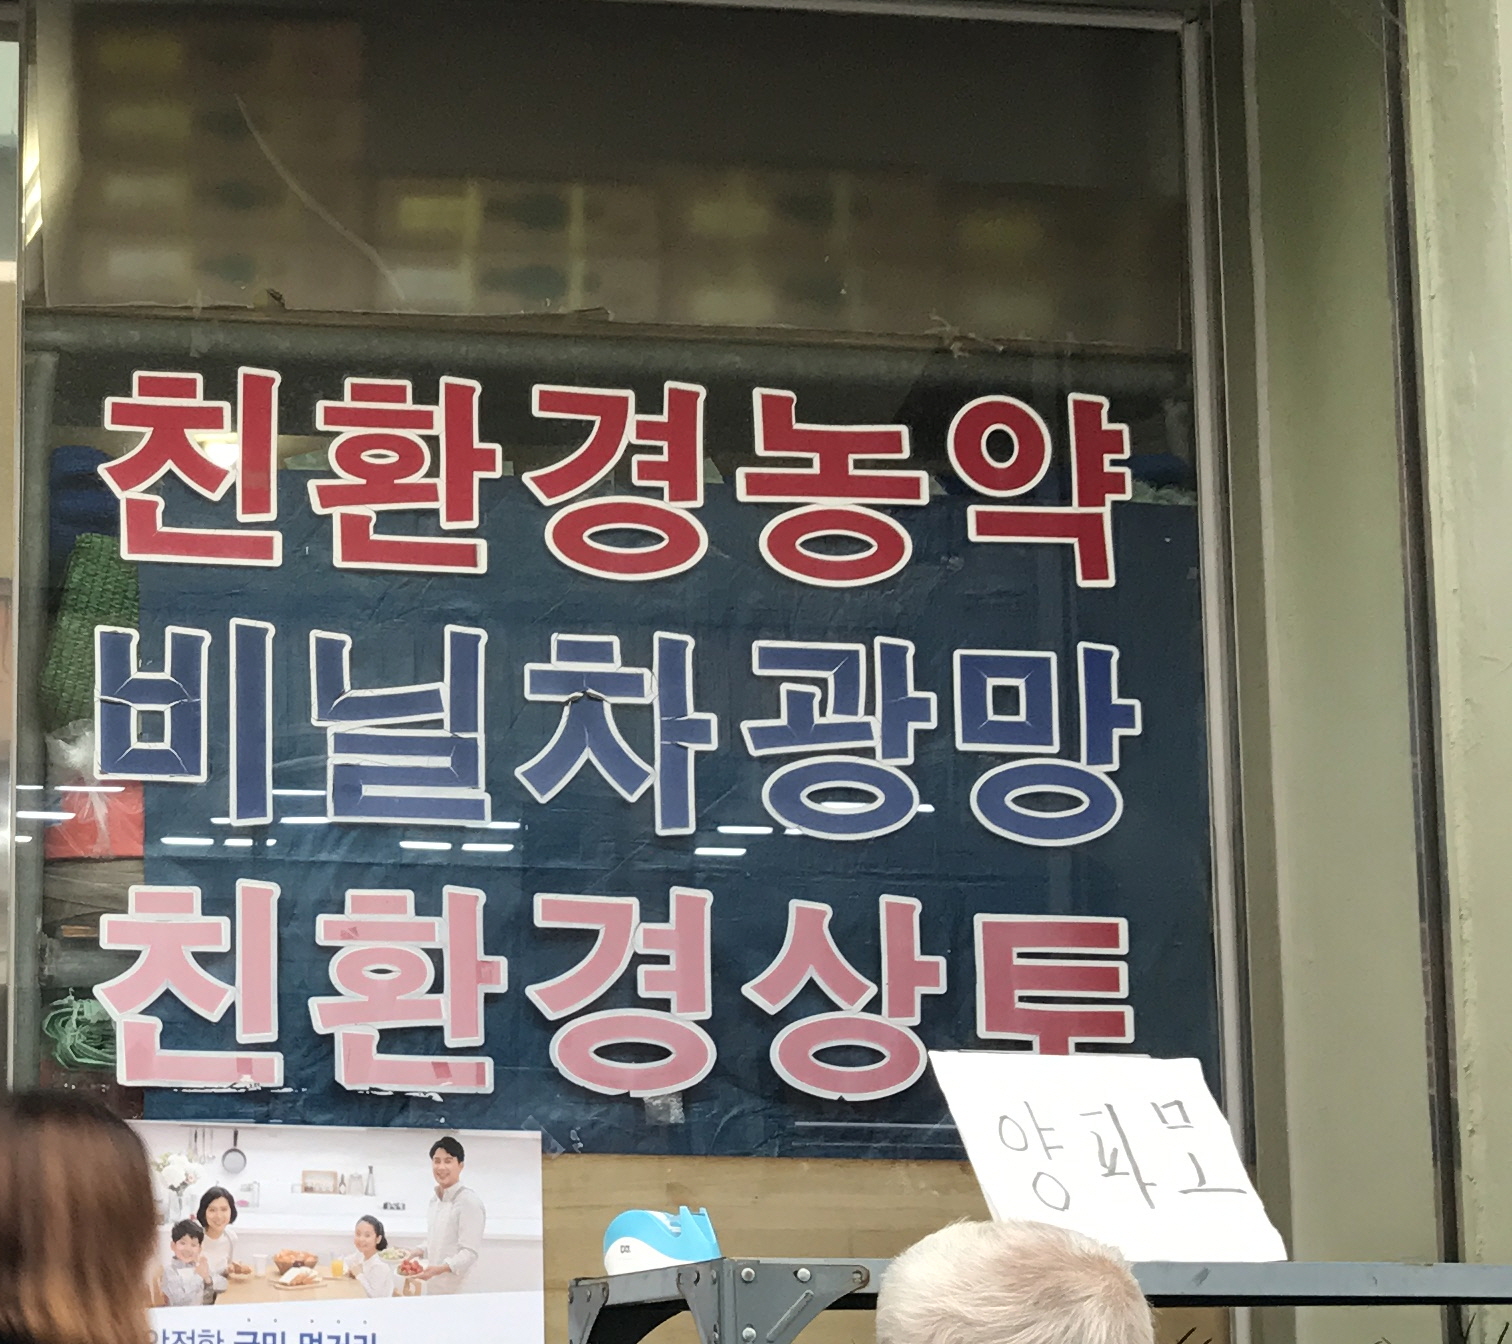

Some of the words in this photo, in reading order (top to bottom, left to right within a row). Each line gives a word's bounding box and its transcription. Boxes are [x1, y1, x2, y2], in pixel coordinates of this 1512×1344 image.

[96, 365, 1134, 588] 친환경농약
[92, 618, 1143, 847] 비닐차광망
[92, 877, 1136, 1103] 친환경상토
[998, 1099, 1248, 1213] 양파모
